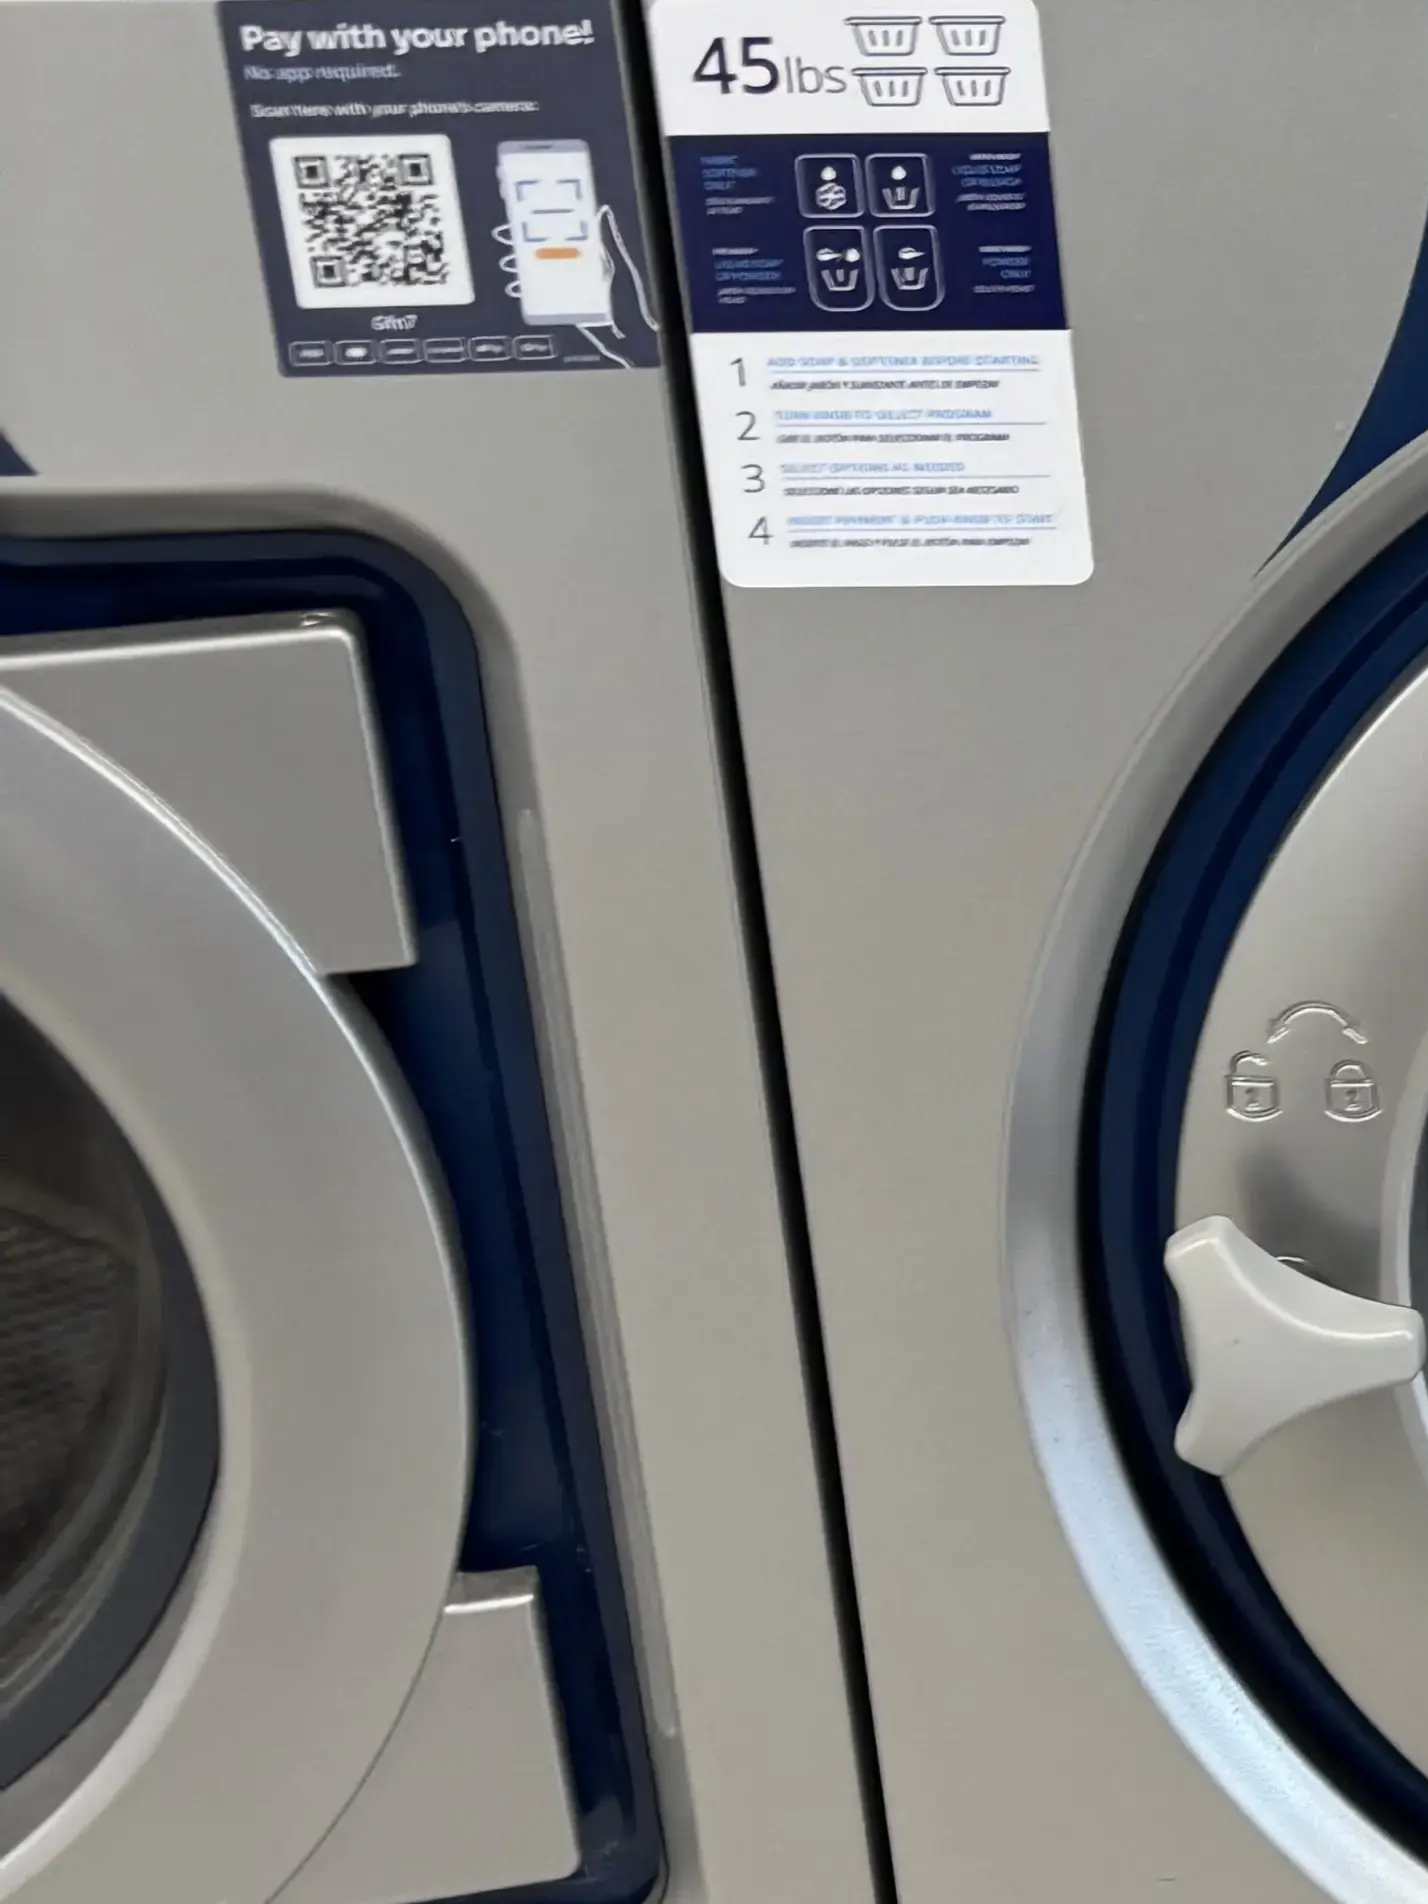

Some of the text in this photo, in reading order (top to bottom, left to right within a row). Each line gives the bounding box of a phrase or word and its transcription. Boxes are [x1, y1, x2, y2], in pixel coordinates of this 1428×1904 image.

[239, 19, 595, 57] Pay with your phone!
[243, 64, 271, 80] No
[275, 66, 312, 83] app
[692, 36, 848, 95] 45lbs
[730, 357, 746, 387] 1
[735, 410, 762, 441] 2
[741, 463, 766, 494] 3
[748, 516, 774, 545] 4
